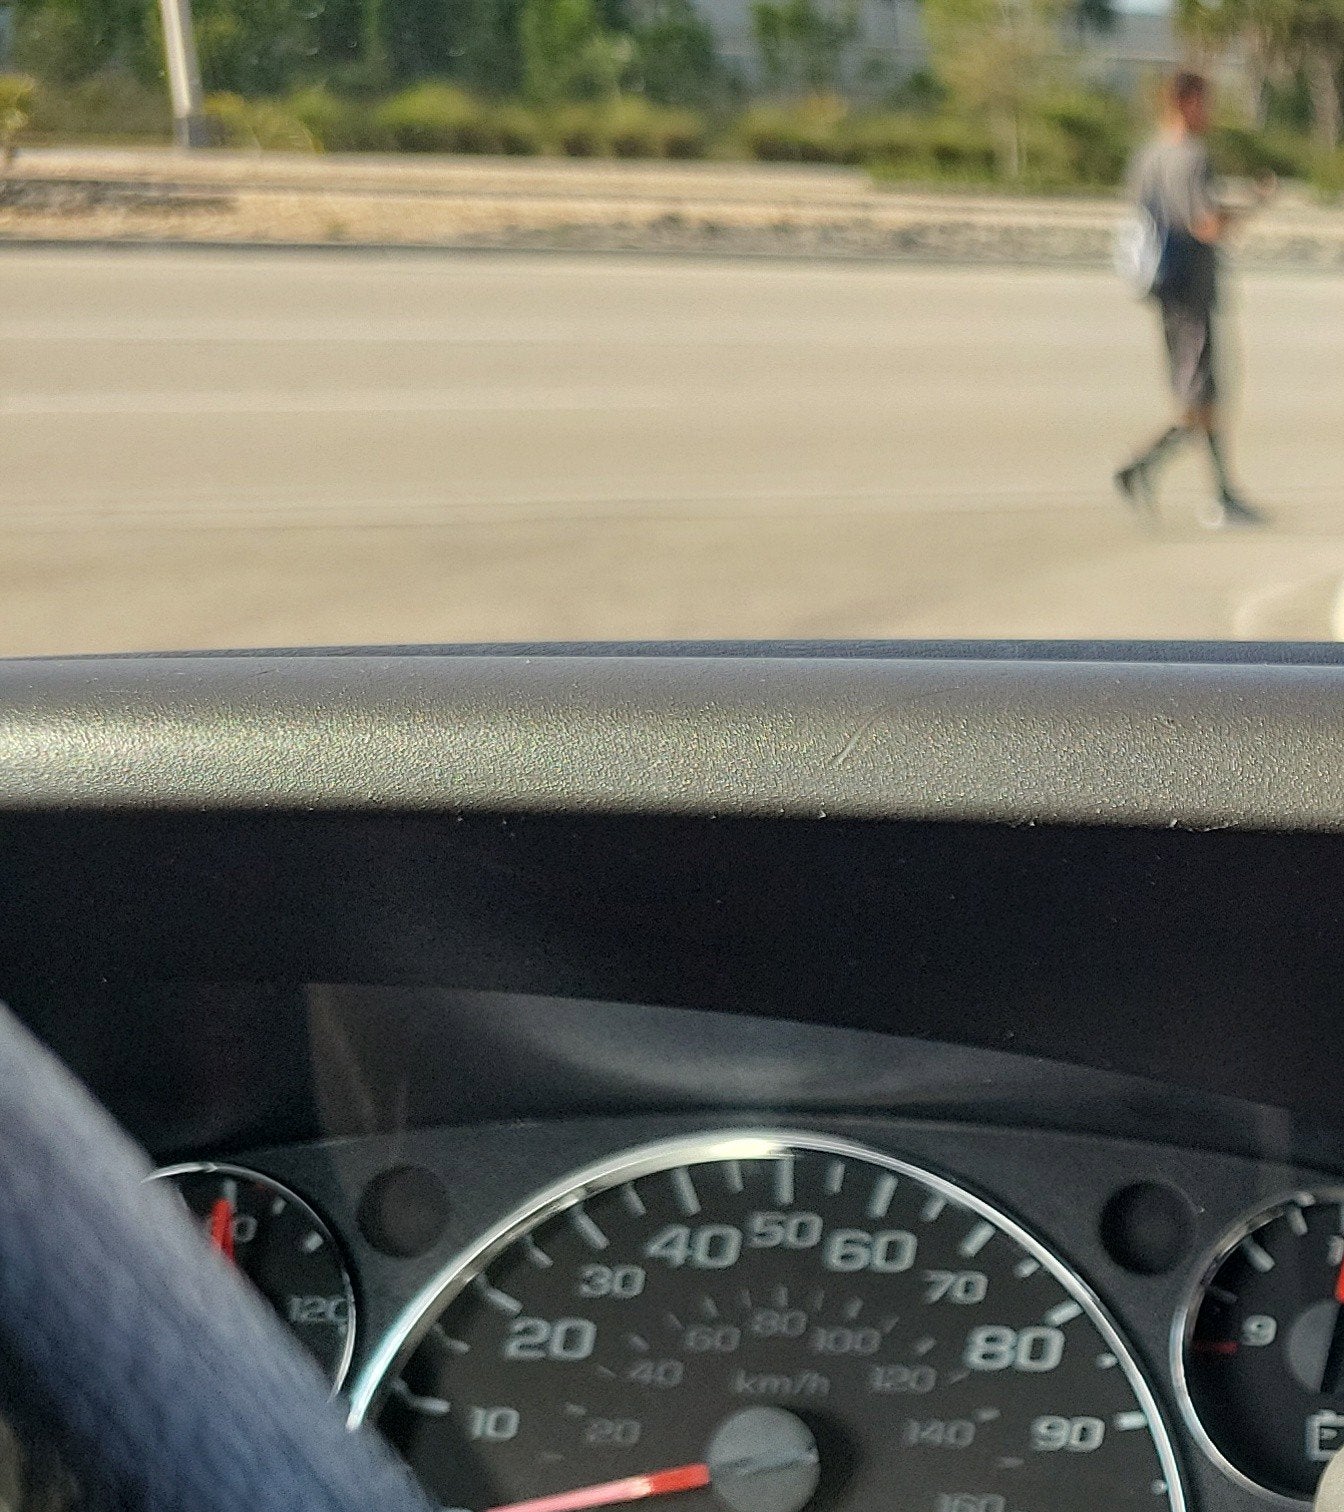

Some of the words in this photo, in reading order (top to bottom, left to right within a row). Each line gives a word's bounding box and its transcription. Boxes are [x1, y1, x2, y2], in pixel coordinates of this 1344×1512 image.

[471, 1407, 520, 1441] 10
[504, 1317, 597, 1361] 20
[580, 1263, 647, 1299] 30
[648, 1223, 743, 1269] 40
[751, 1211, 823, 1250] 50
[824, 1229, 917, 1273] 60
[921, 1270, 988, 1305] 70
[963, 1324, 1065, 1372] 80
[1031, 1415, 1105, 1452] 90
[1241, 1315, 1277, 1346] 9
[586, 1418, 642, 1446] 20
[628, 1358, 684, 1388] 40
[685, 1325, 741, 1352] 60
[751, 1308, 808, 1337] 80
[808, 1326, 881, 1354] 100
[869, 1364, 937, 1394] 120
[906, 1418, 976, 1449] 140
[731, 1369, 830, 1398] km/h
